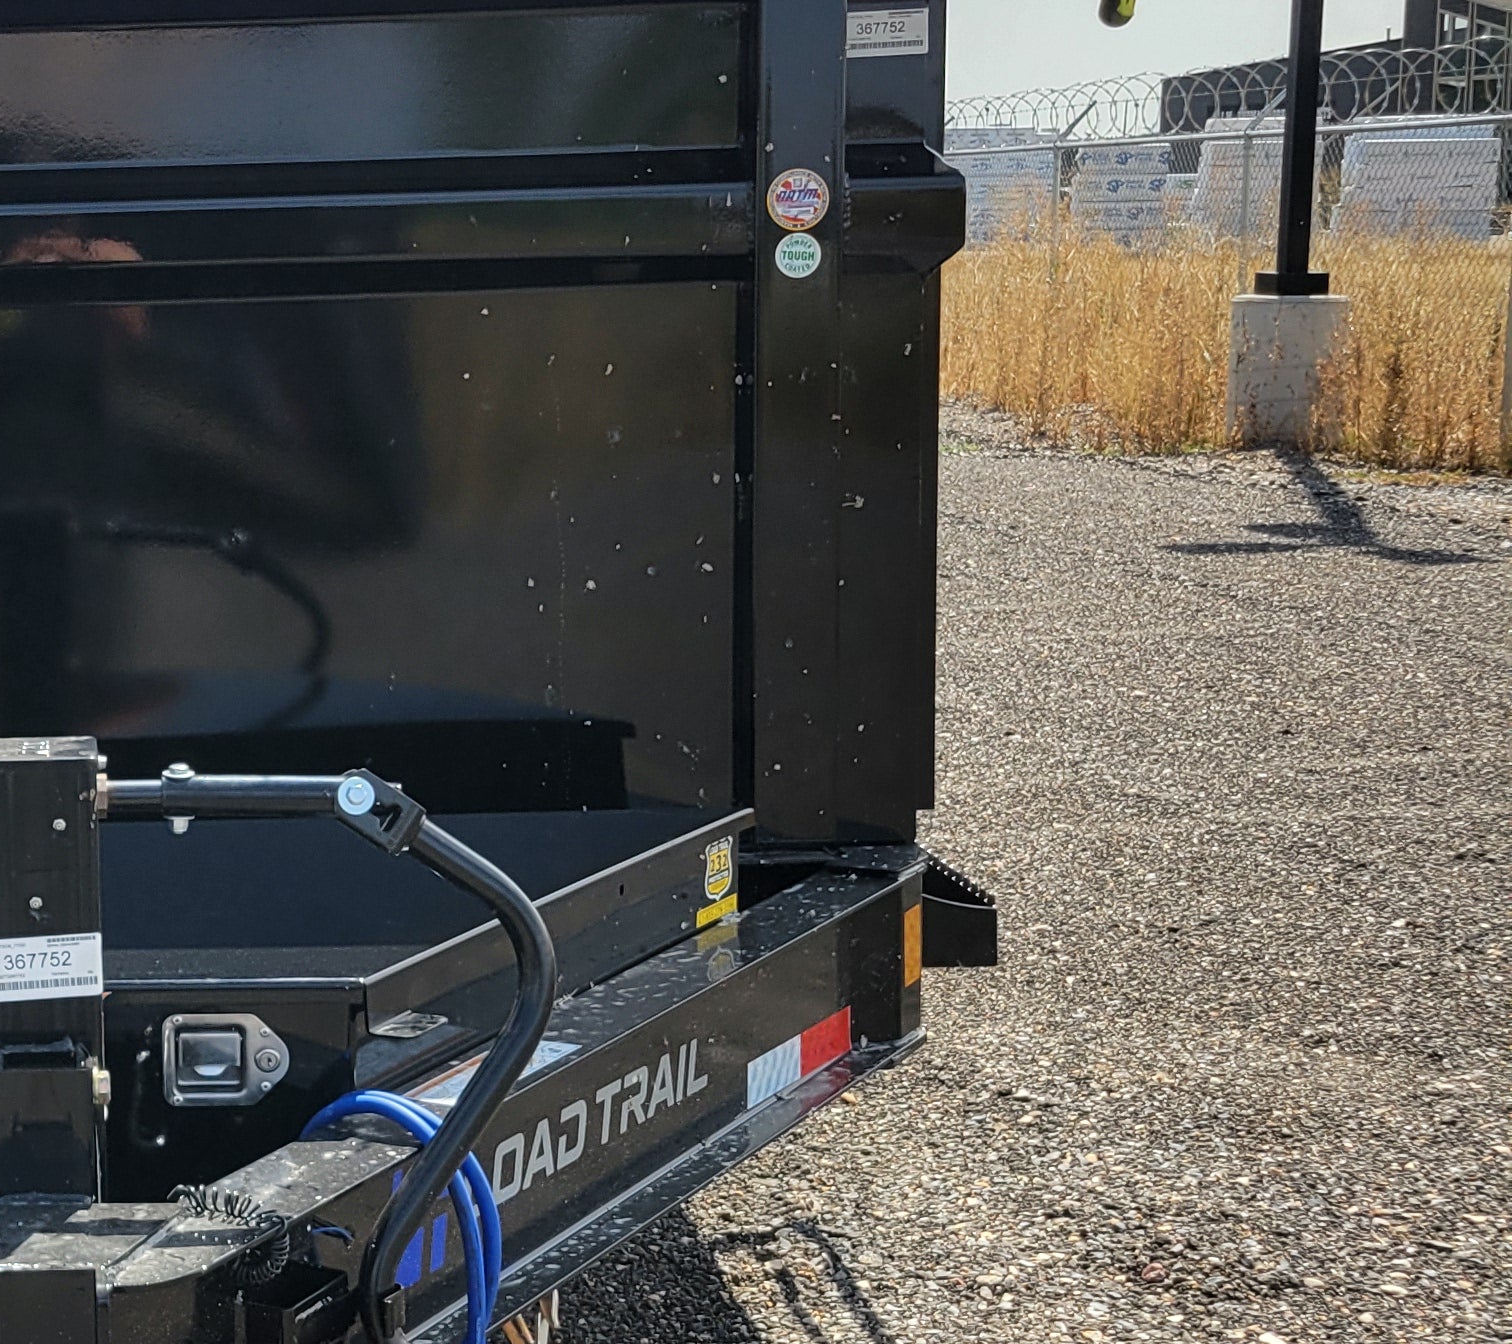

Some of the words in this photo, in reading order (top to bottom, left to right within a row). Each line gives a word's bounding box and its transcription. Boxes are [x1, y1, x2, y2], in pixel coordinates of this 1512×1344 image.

[856, 20, 906, 35] 367752
[782, 251, 814, 261] TOUGH
[711, 854, 727, 872] 232
[3, 950, 72, 971] 367752
[492, 1099, 588, 1205] OAD
[595, 1039, 709, 1145] TRAIL
